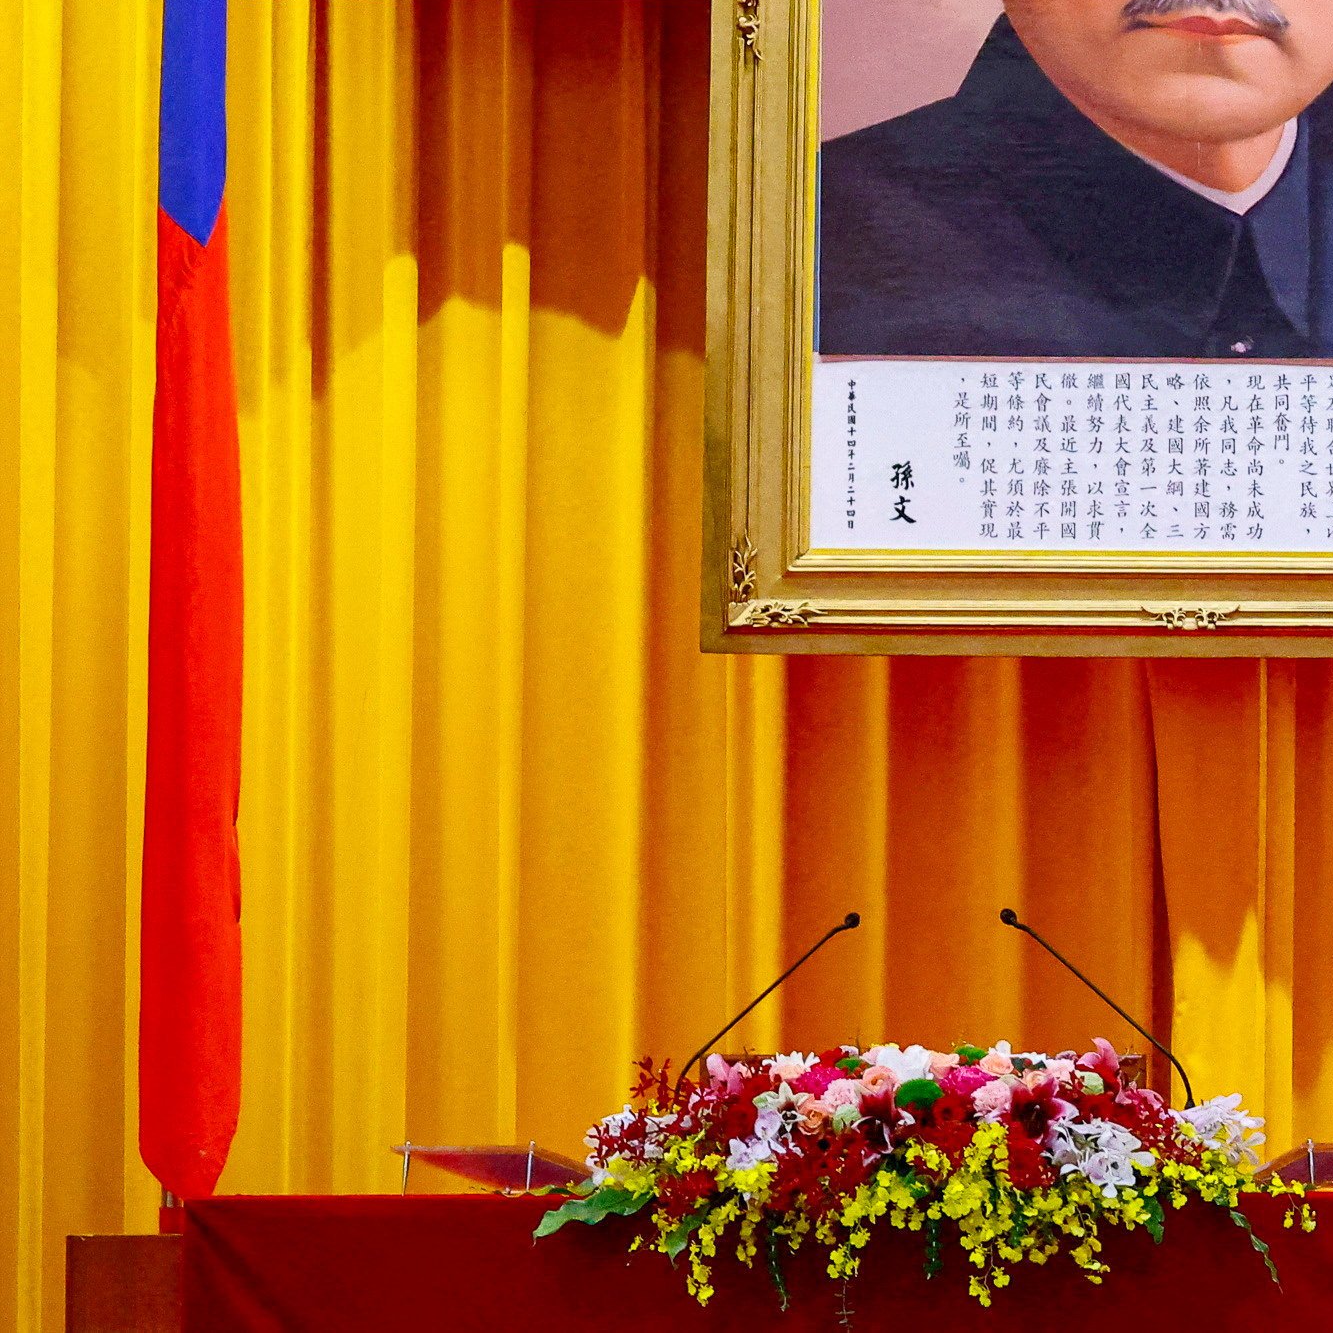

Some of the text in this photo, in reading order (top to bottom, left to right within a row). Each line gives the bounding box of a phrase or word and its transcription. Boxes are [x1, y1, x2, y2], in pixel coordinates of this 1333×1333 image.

[846, 378, 857, 530] 中華民國十四年二月二十四日
[888, 460, 918, 525] 孫文
[1032, 372, 1053, 540] 民會議及廢除不平
[1139, 373, 1159, 540] 民主義及第一次全
[1165, 372, 1186, 538] 略、建國大綱、三
[1192, 373, 1212, 540] 依照余所著建國方
[1246, 374, 1266, 540] 現在革命尚未成功
[1272, 373, 1292, 465] 共同奮鬥。
